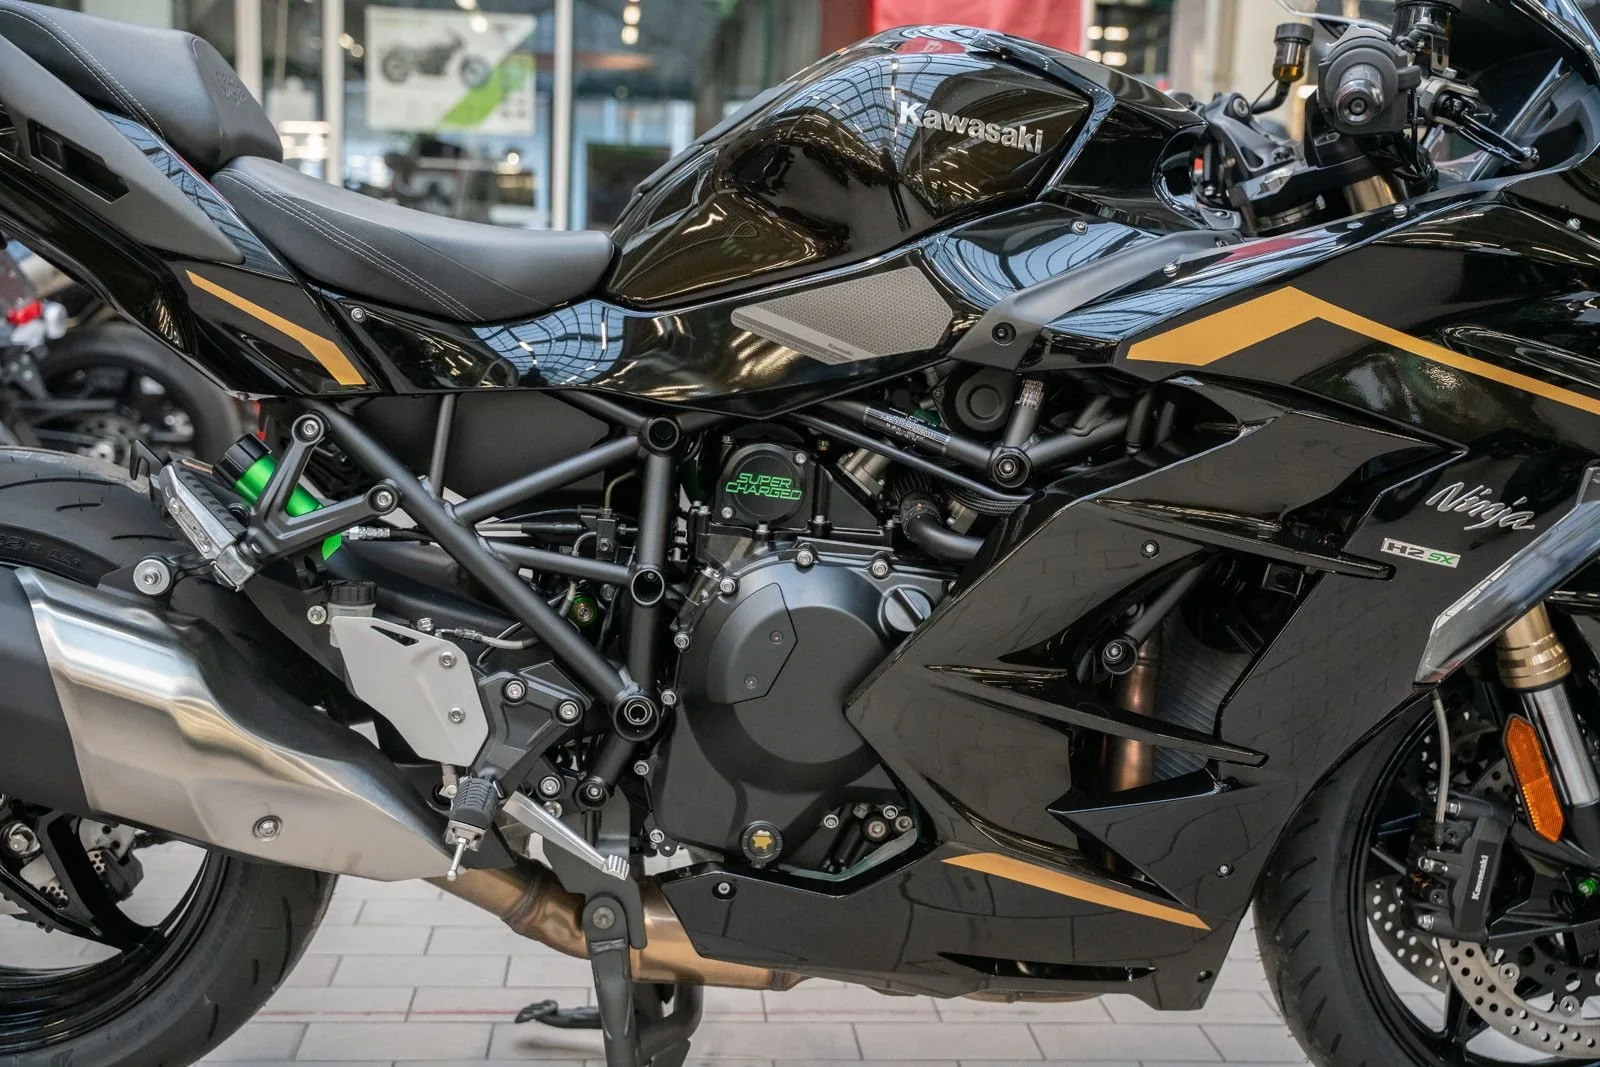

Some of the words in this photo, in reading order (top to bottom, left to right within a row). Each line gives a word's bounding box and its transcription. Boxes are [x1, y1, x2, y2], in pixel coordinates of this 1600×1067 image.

[898, 101, 1043, 154] Kawasaki
[725, 482, 802, 500] CHARGED
[736, 473, 792, 488] SUPER
[1425, 481, 1535, 531] Ninja
[1387, 542, 1424, 559] H2
[1427, 552, 1454, 564] SX
[1471, 855, 1489, 900] Kawasaki
